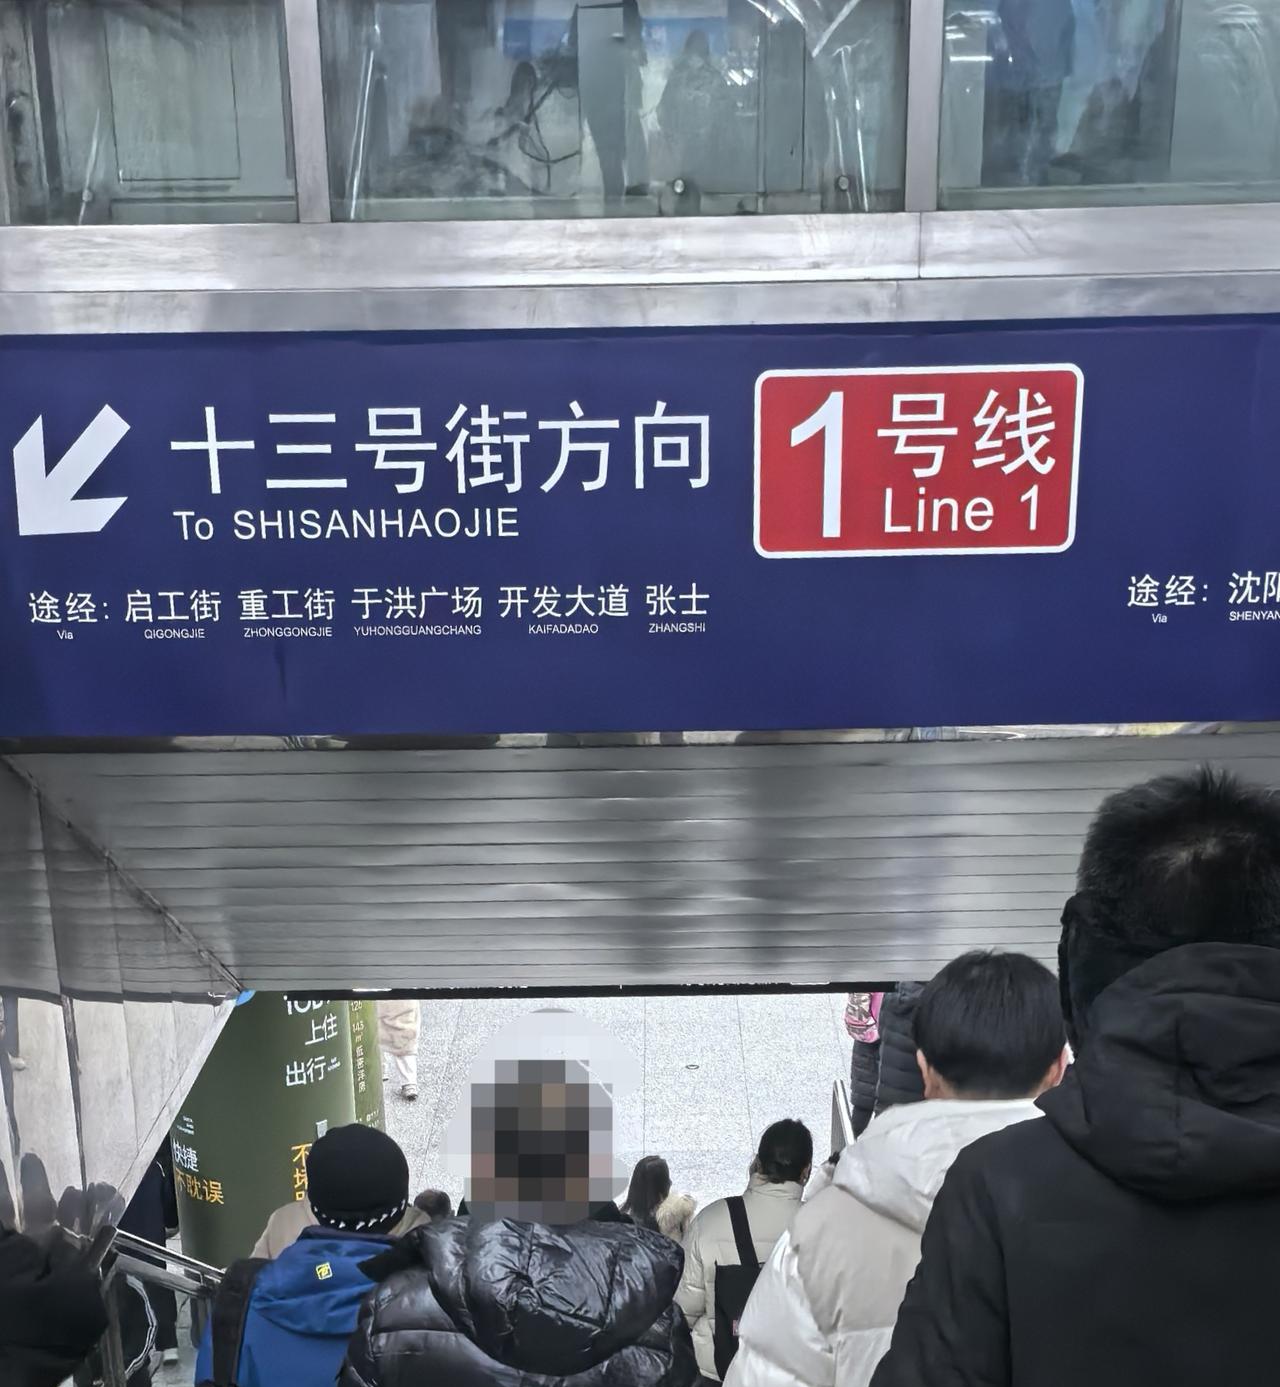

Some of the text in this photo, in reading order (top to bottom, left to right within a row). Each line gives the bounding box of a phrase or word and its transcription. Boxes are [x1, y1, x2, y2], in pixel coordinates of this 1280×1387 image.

[171, 400, 709, 495] 十三号街方向
[173, 507, 519, 541] To SHISANHAOJIE
[884, 484, 1039, 533] Line 1
[125, 589, 222, 623] 启工街
[237, 587, 336, 621] 重工街
[351, 585, 483, 620] 于洪广场
[497, 583, 630, 619] 开发大道
[645, 582, 710, 616] 张士
[1151, 613, 1168, 623] Via
[57, 622, 706, 640] Via QIGONGJIE ZHONGGONGJIE YUHONGGUANGCHANG KAIFADADAO ZHANGSHI
[304, 1012, 339, 1046] 上住
[285, 1055, 327, 1087] 出行
